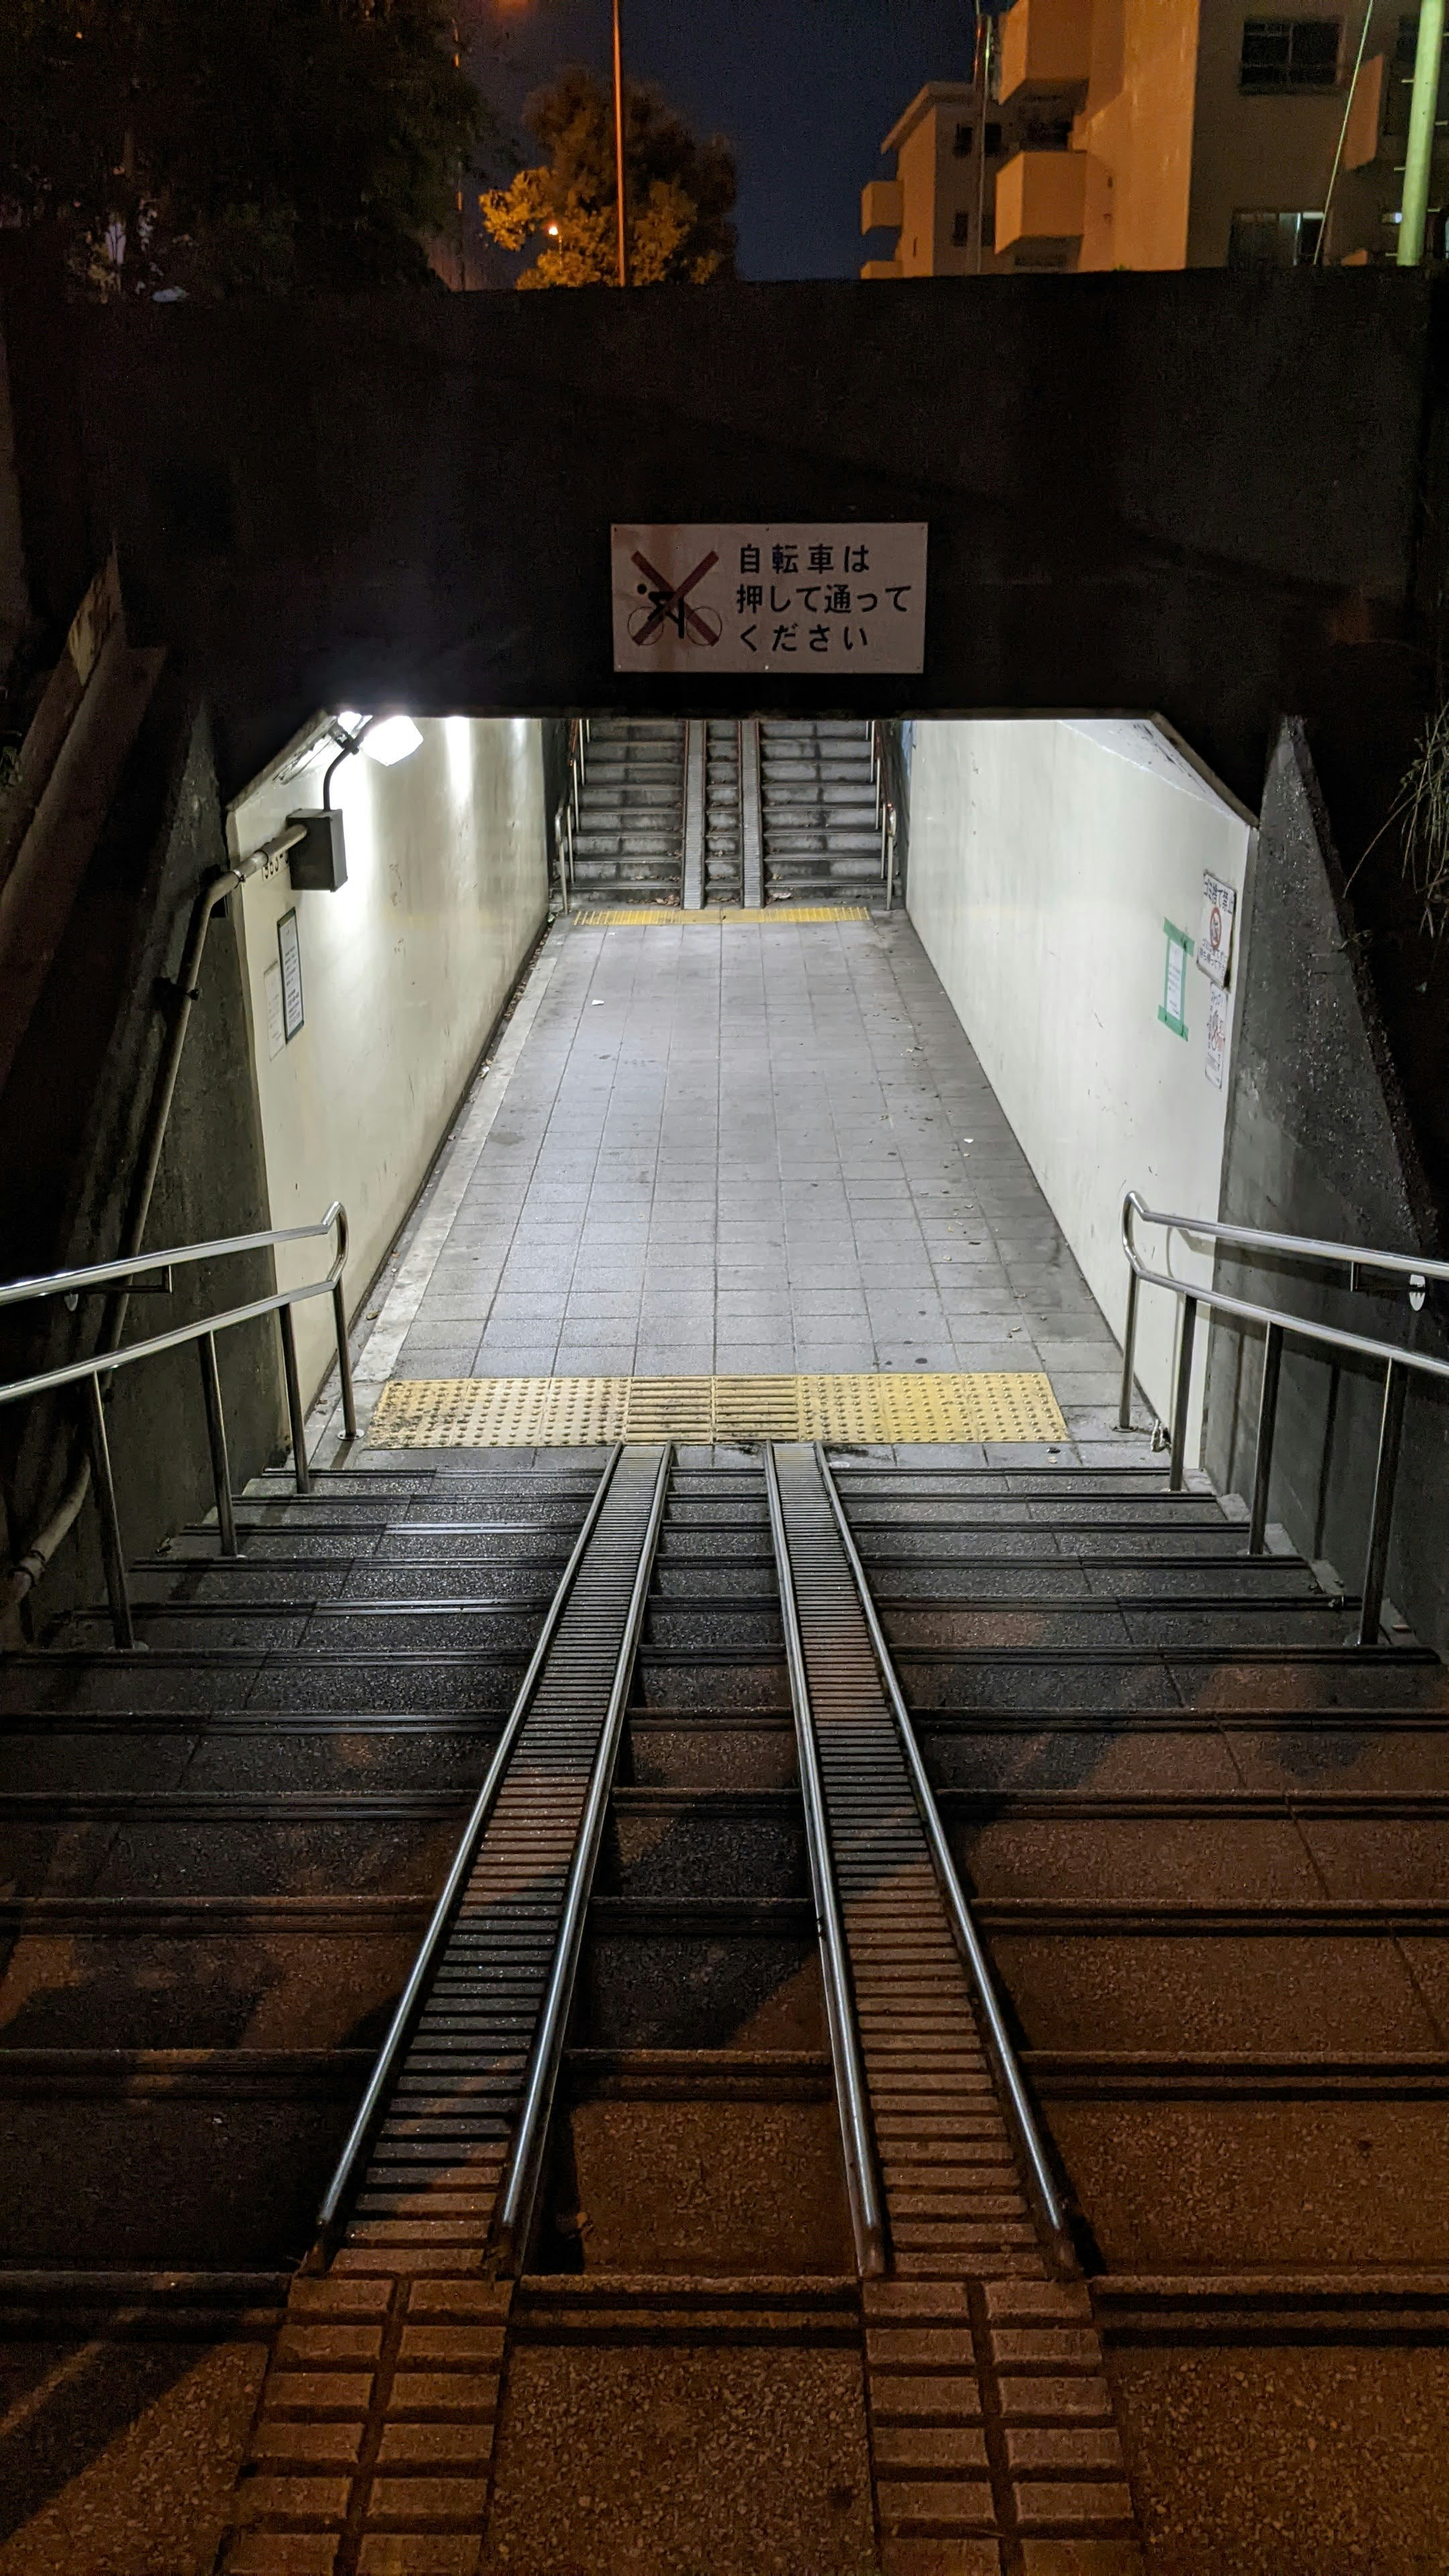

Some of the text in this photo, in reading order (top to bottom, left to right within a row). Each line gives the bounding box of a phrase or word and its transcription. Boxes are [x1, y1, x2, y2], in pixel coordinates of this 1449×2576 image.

[740, 543, 870, 574] 自転車は
[737, 584, 911, 614] 押して通って
[740, 623, 867, 652] ください
